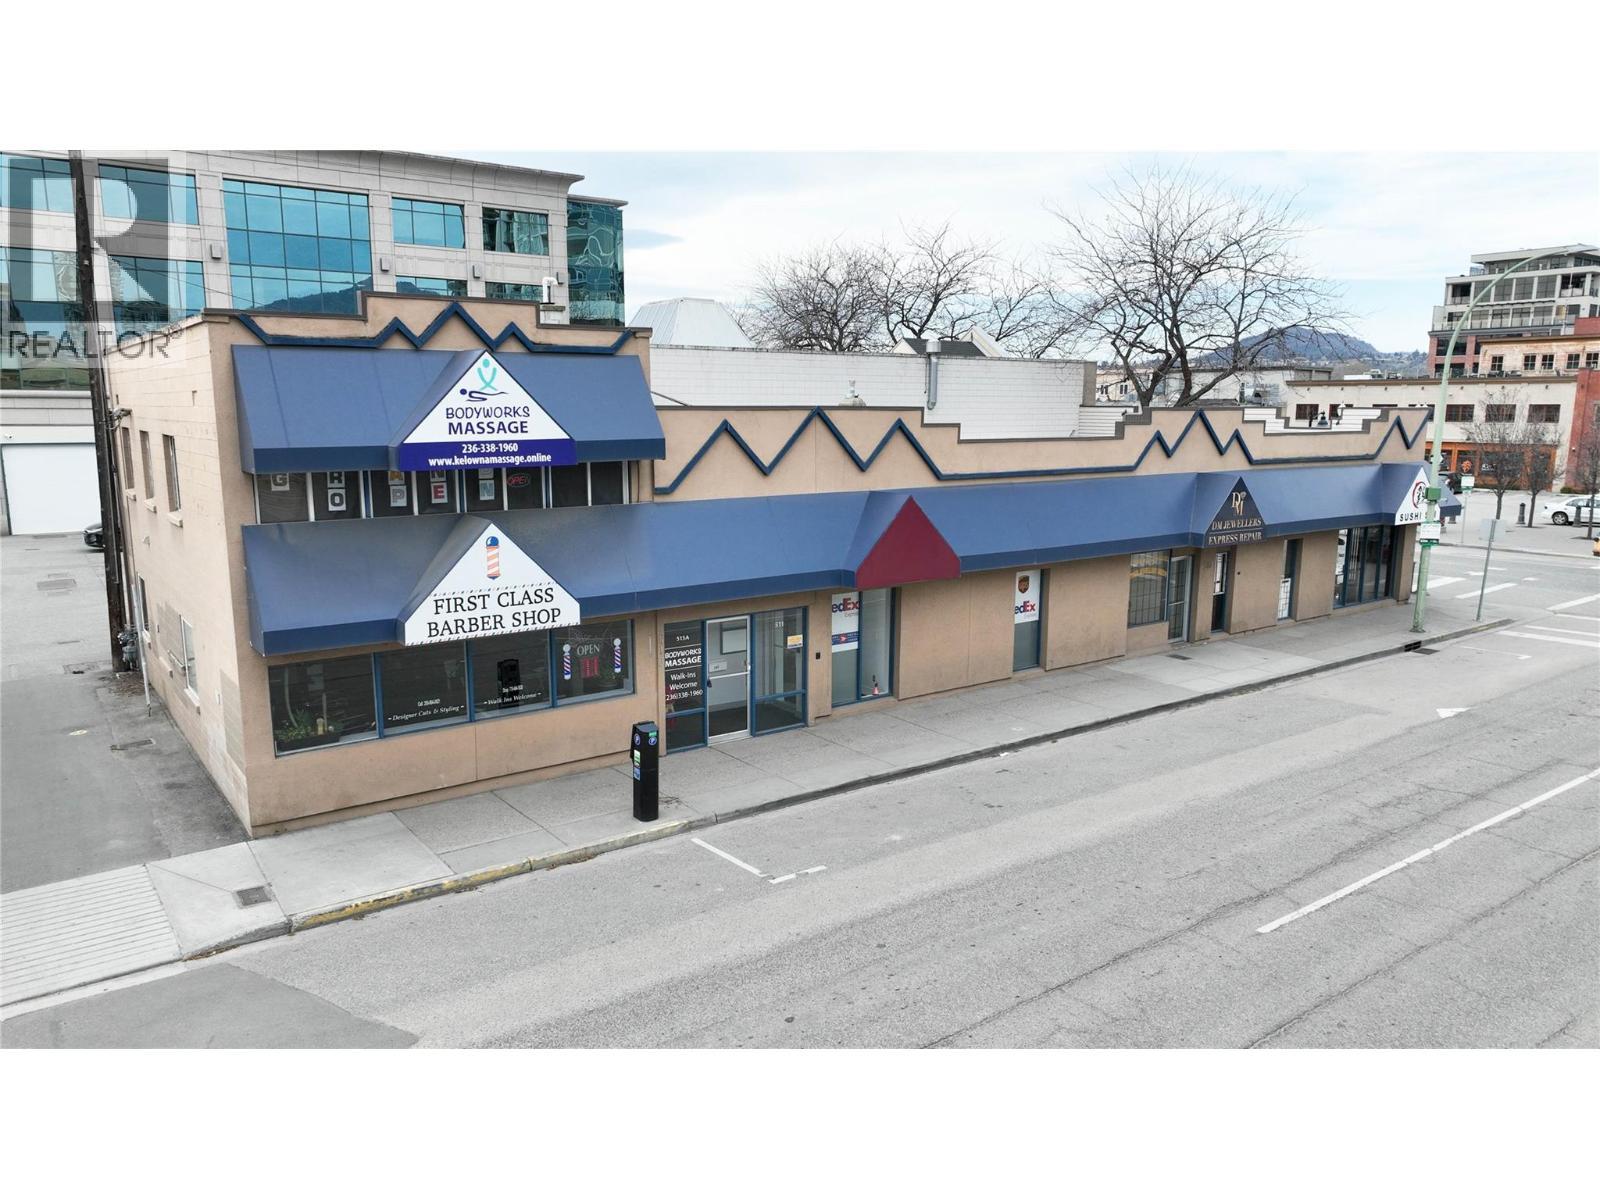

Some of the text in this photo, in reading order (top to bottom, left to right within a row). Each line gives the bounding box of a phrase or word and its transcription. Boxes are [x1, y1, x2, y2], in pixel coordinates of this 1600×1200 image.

[445, 405, 530, 419] BODYWORKS
[448, 421, 529, 435] MASSAGE
[461, 442, 519, 454] 236-338-1960
[428, 453, 552, 467] www.kelownamassage.online
[1399, 511, 1422, 521] SUSHI
[1223, 518, 1262, 529] JEWELLERS
[1208, 531, 1262, 545] EXPRESS REPAIR
[433, 587, 554, 615] FIRST CLASS
[427, 608, 561, 638] BARBER SHOP
[576, 643, 600, 656] OPEN
[665, 648, 702, 659] BODYWORKS
[665, 655, 702, 668] MASSAGE
[670, 681, 698, 690] Welcome
[513, 693, 537, 701] Welcome
[392, 712, 417, 721] Designer
[440, 705, 460, 714] Styling
